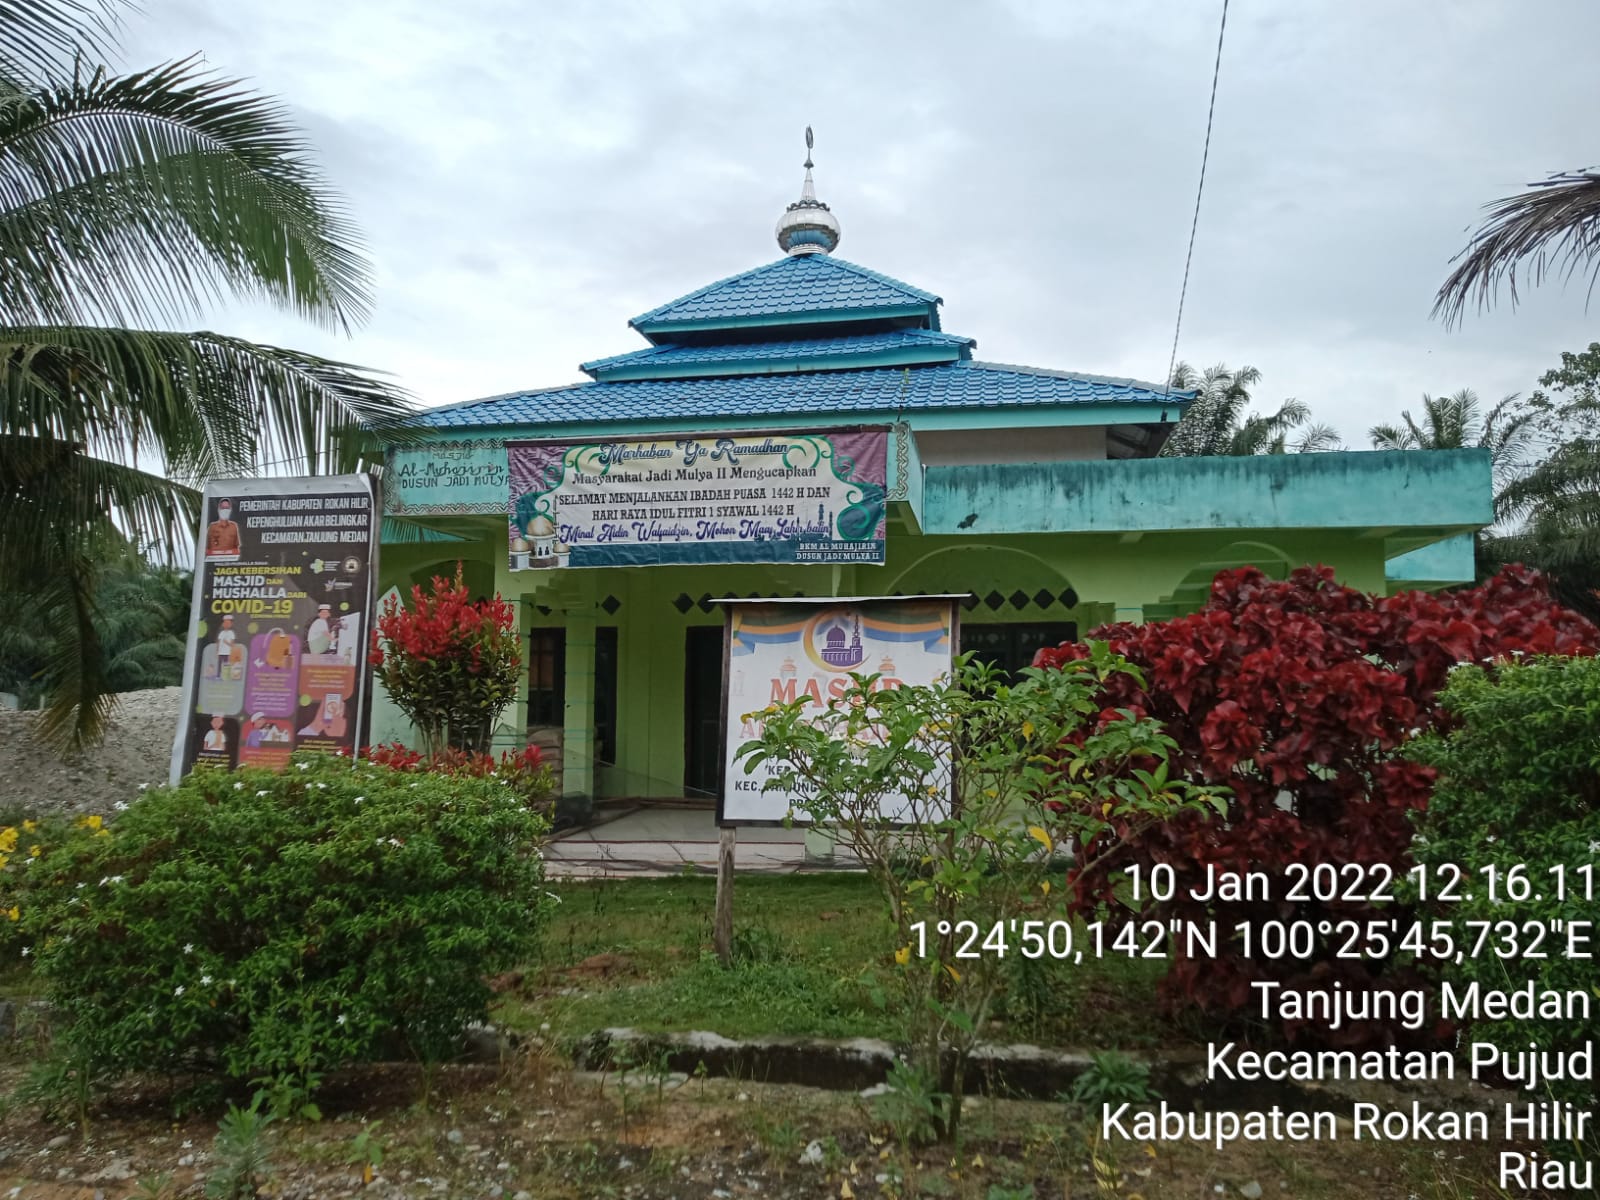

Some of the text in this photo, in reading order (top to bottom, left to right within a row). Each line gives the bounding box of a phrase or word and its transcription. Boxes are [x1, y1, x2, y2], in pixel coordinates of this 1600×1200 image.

[599, 438, 789, 466] Marhaban Ya Ramadhan
[402, 477, 438, 489] DUSUN
[444, 476, 470, 487] JADI
[572, 465, 817, 486] Masyarakat Jadi Mulya II Mengucapkan
[559, 486, 831, 506] SELAMAT MENJALANKAN IBADAH PUASA 1442 H DAN
[239, 497, 369, 512] PEMERINTAH KABUPATEN ROKAN HILIR
[592, 504, 795, 521] HARI RAYA IDUL FITRI 1 SYAWAL 1442 H
[303, 515, 325, 528] AKAR
[325, 514, 368, 527] BELINGKAR
[261, 531, 368, 544] KECAMATAN TANJUNG MEDAN
[559, 524, 594, 544] Minal
[596, 523, 629, 543] Aidin
[695, 519, 736, 540] Mohon
[796, 552, 823, 561] DUSUN
[823, 552, 842, 561] JADI
[843, 552, 871, 560] MULYA
[213, 566, 302, 576] JAGA KEBERSIHAN
[213, 575, 265, 587] MASJID
[212, 587, 287, 599] MUSHALLA
[211, 599, 293, 614] COVID-19
[735, 780, 761, 792] KEC.
